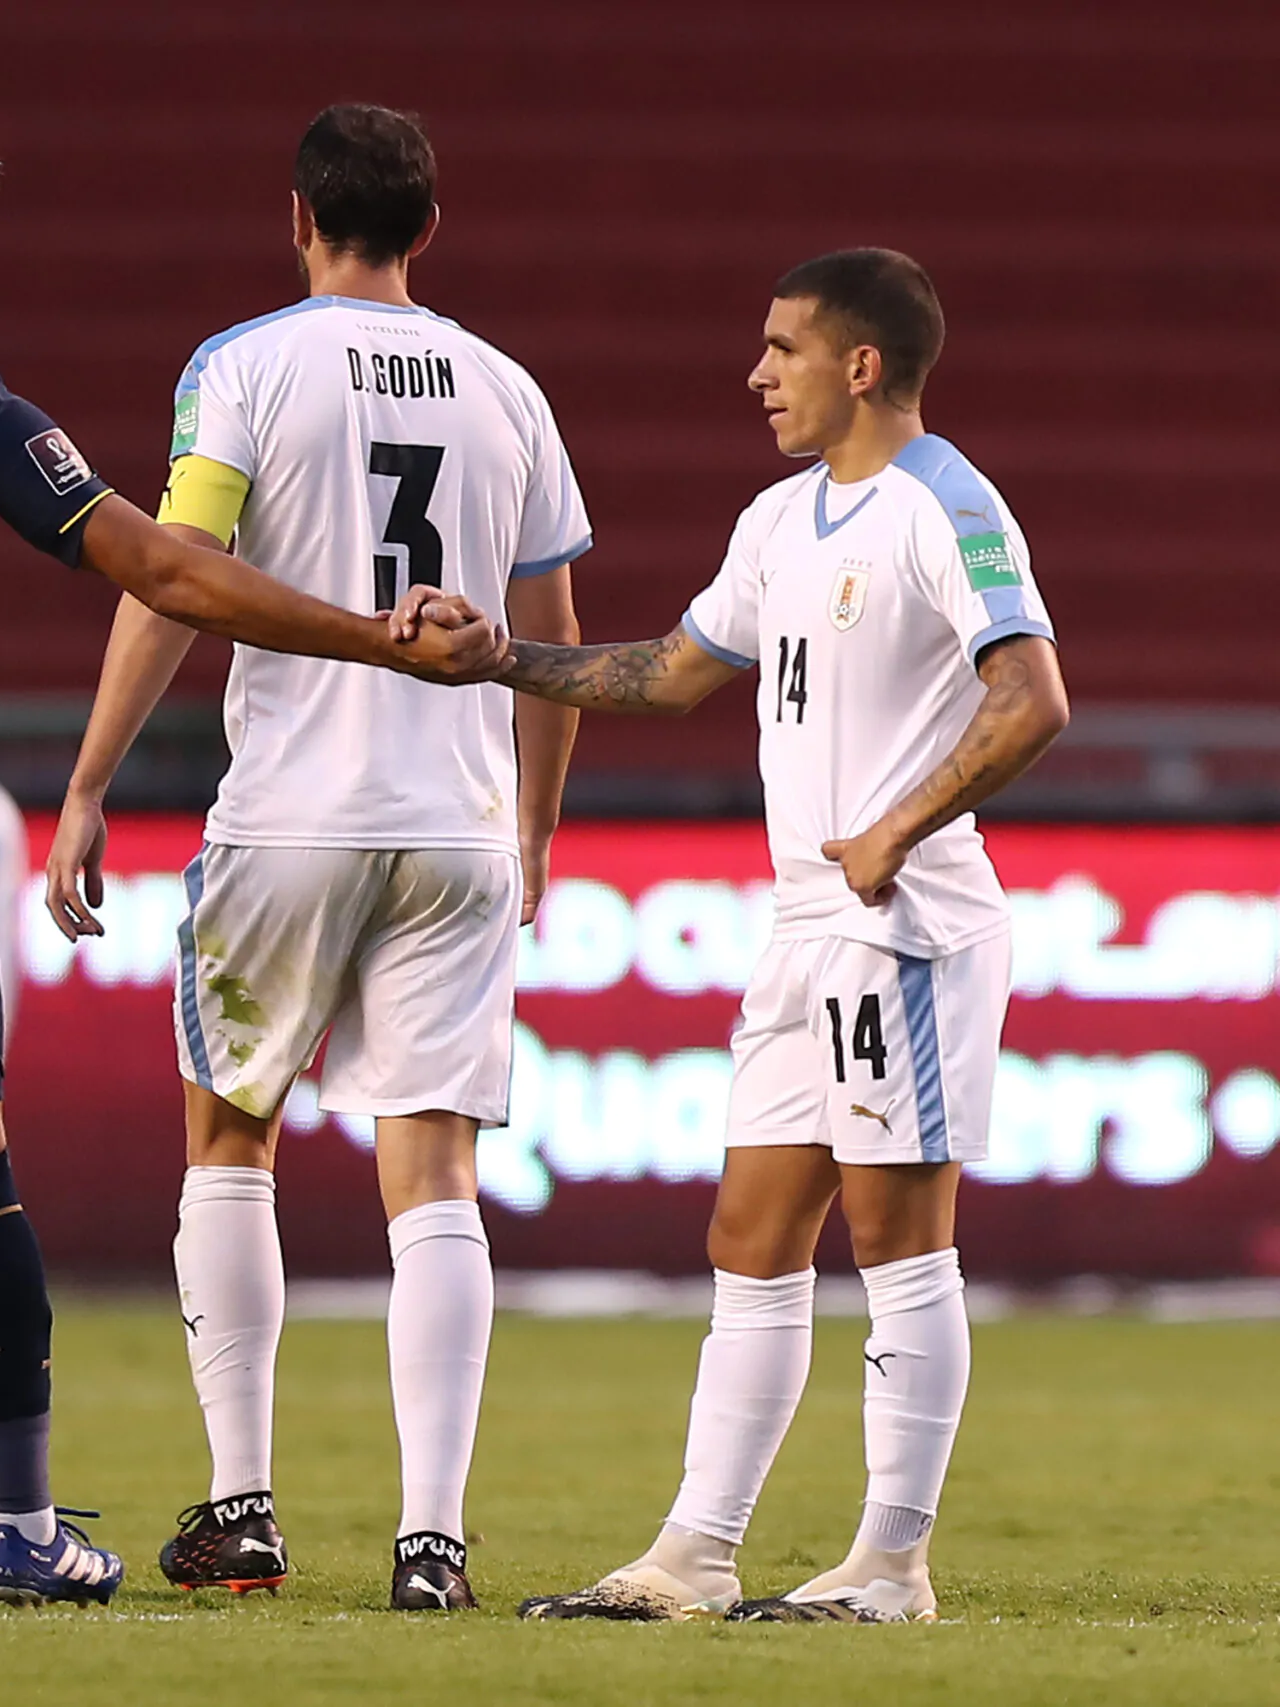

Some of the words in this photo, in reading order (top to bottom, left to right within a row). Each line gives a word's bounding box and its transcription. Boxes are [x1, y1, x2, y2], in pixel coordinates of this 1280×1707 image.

[368, 441, 446, 613] 3
[776, 635, 808, 724] 14
[826, 994, 887, 1083] 14
